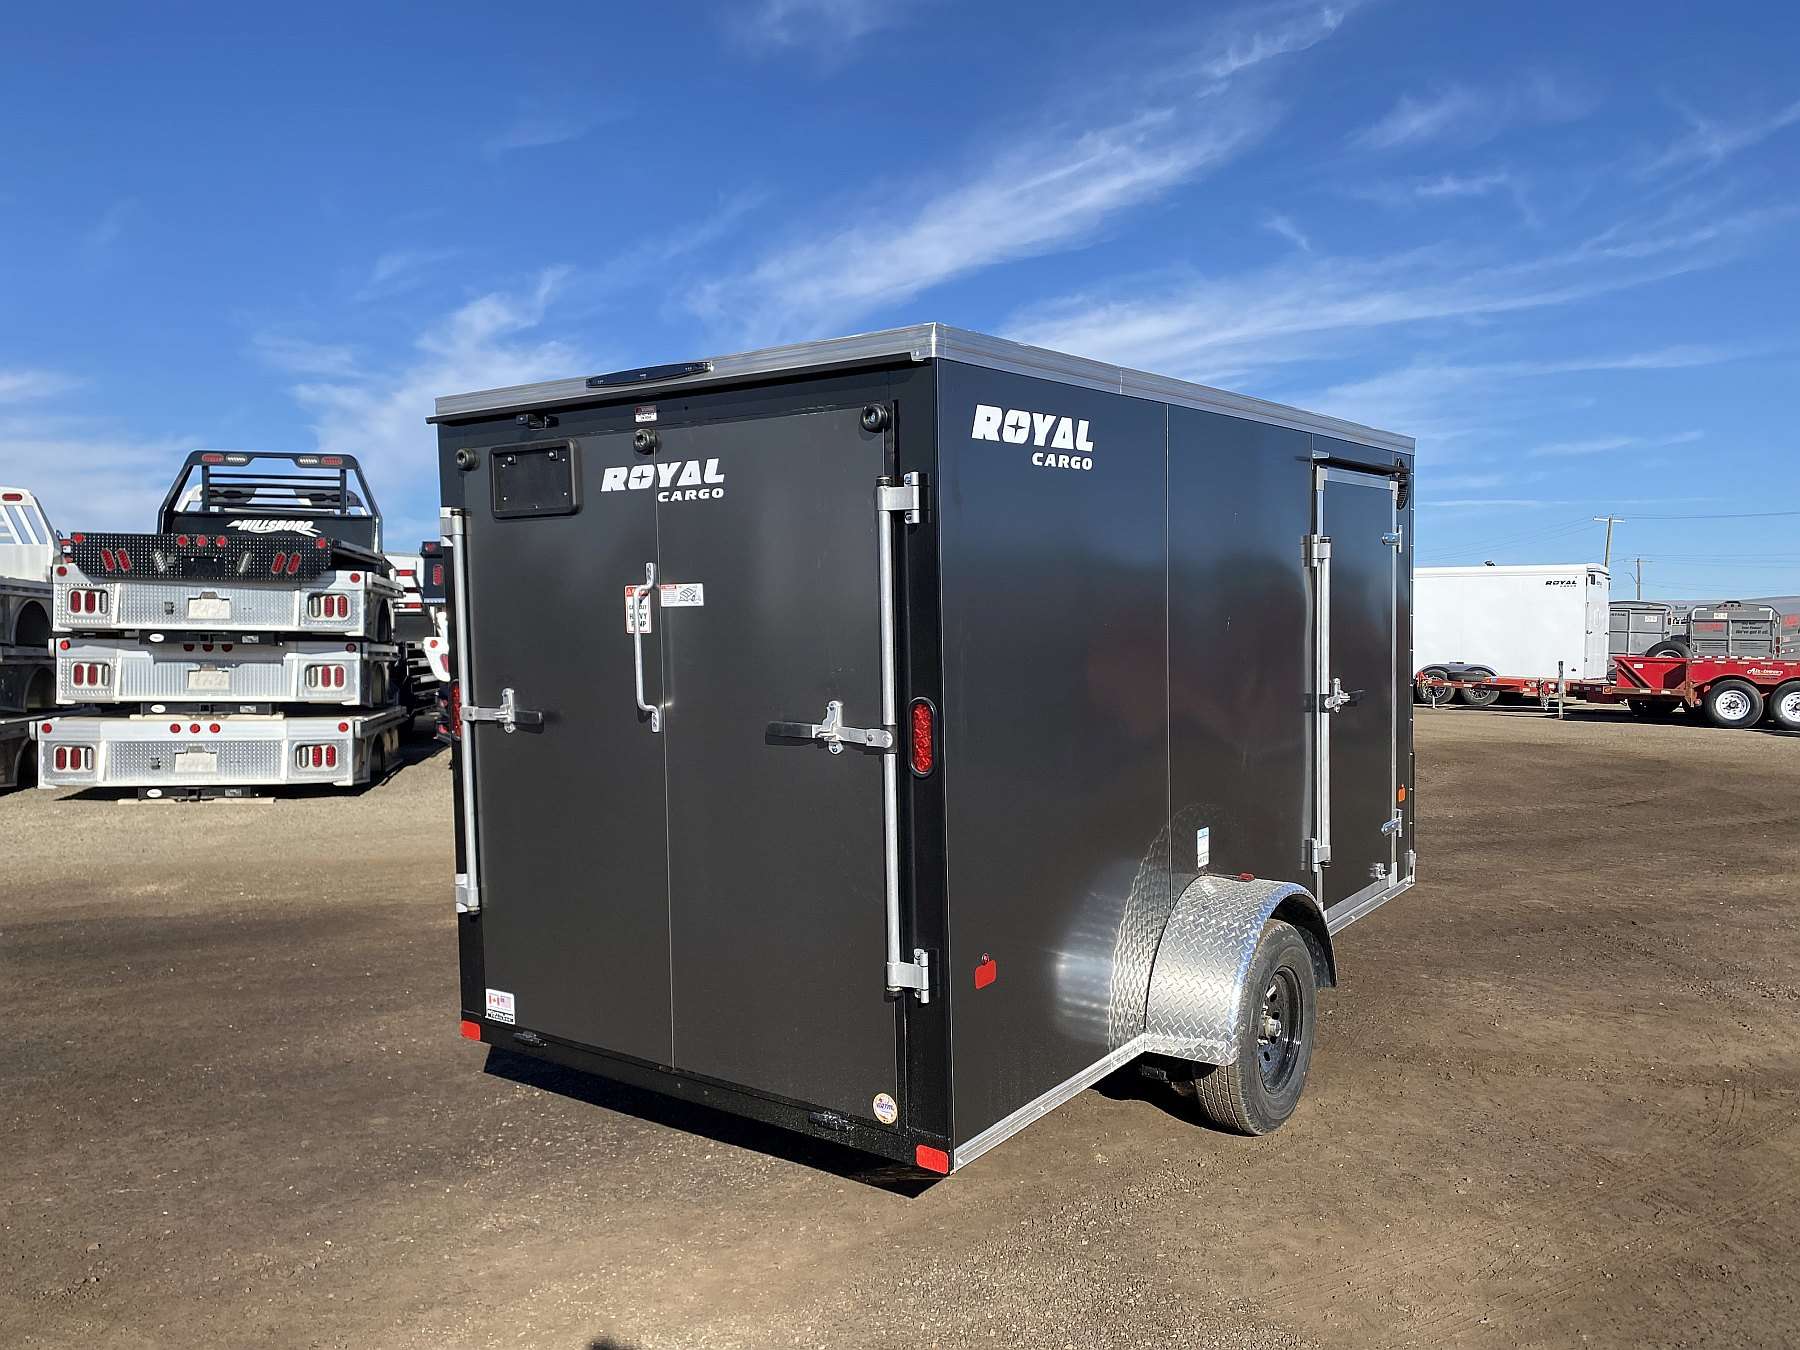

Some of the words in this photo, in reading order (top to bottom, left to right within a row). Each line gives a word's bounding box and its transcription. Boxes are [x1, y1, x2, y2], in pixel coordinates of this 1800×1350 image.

[972, 404, 1094, 452] ROYAL
[1031, 452, 1093, 471] CARGO
[600, 458, 725, 492] ROYAL
[657, 487, 724, 503] CARGO
[232, 519, 316, 533] HILLSBORO
